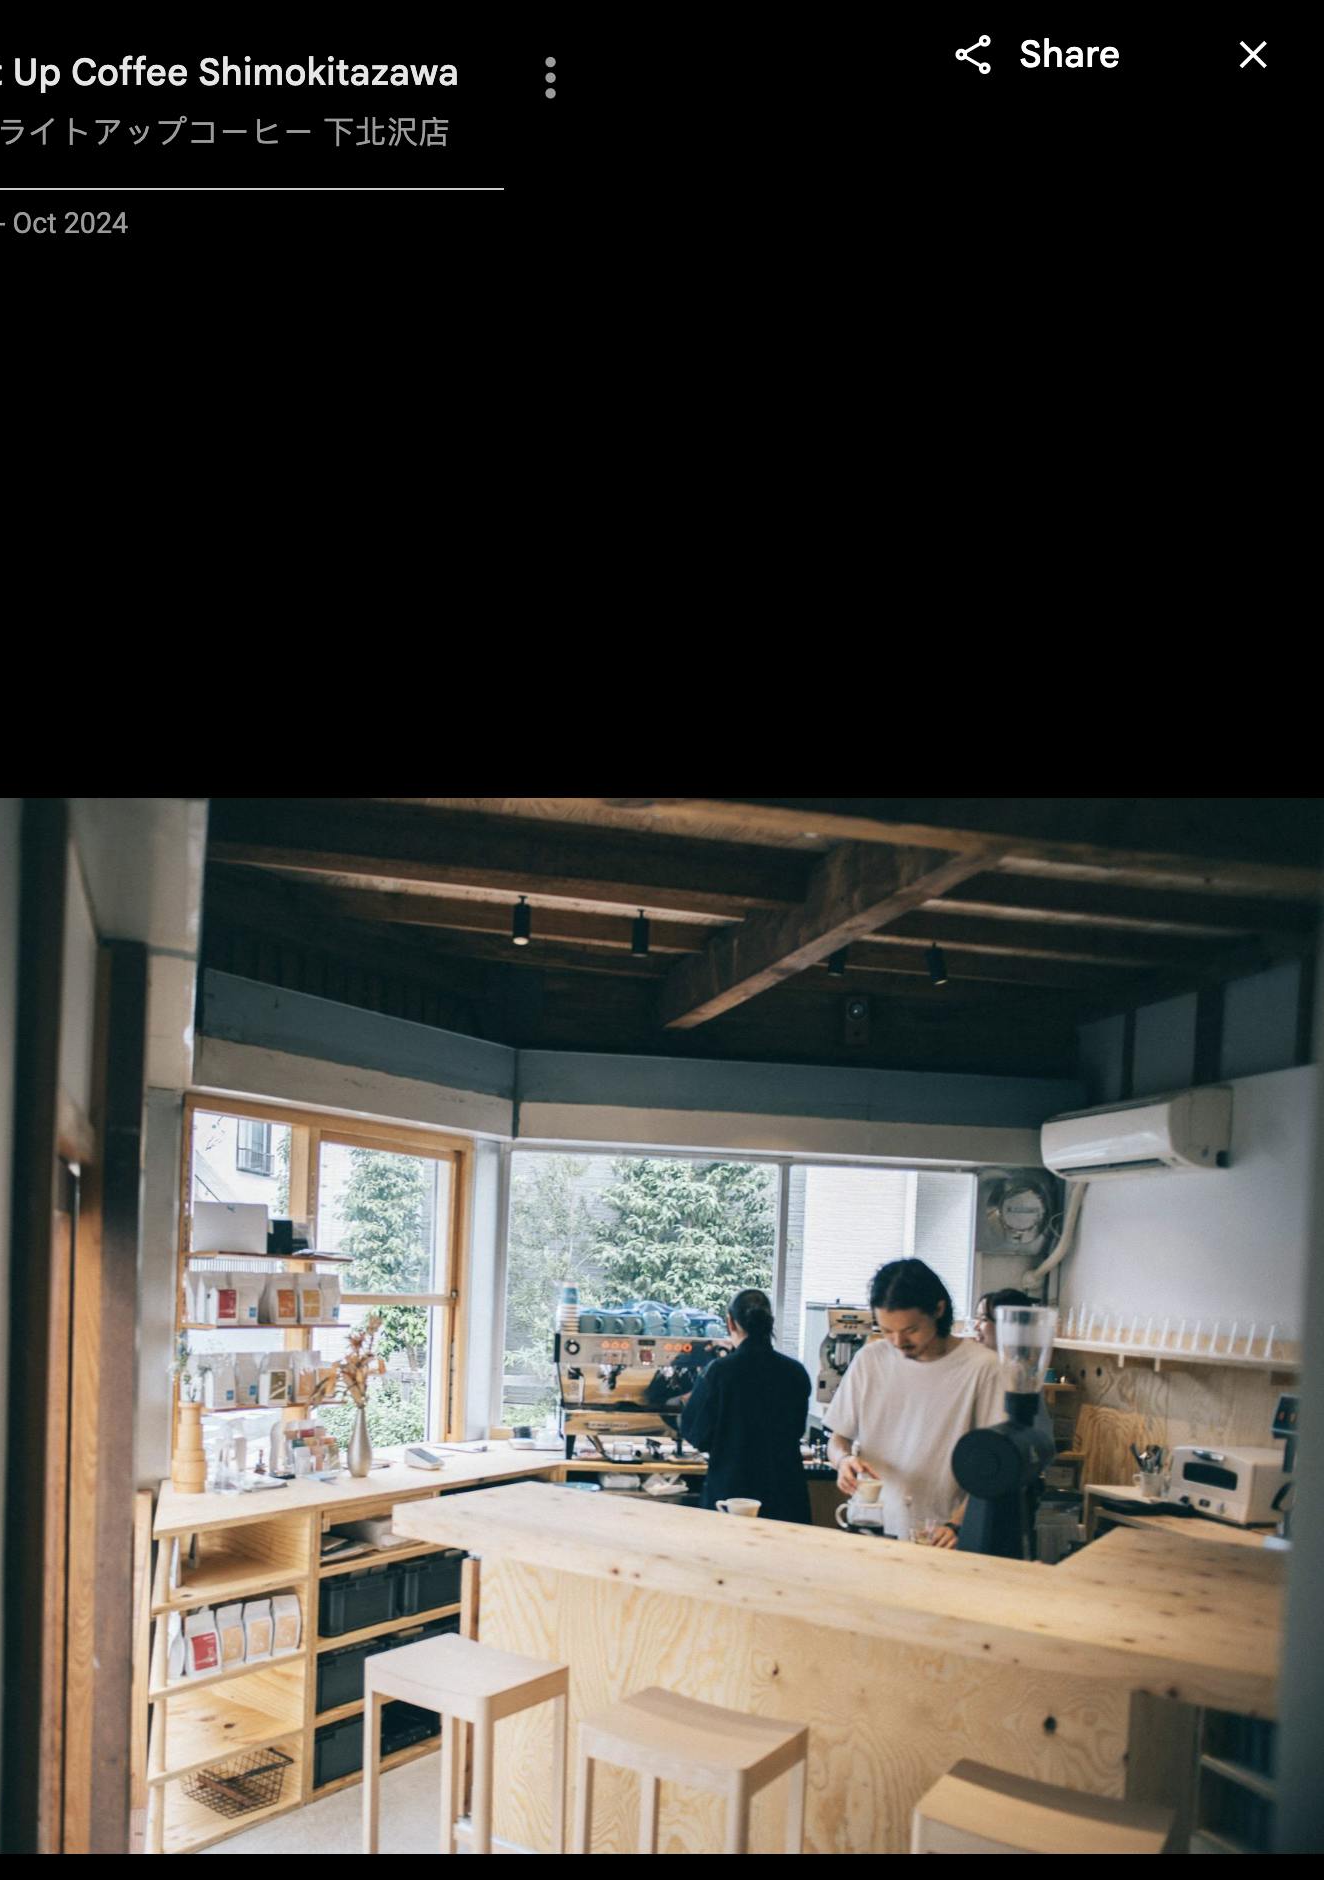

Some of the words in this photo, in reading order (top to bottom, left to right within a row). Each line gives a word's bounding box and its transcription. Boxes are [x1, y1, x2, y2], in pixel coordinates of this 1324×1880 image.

[1019, 37, 1120, 69] Share
[14, 57, 61, 94] Up
[71, 54, 188, 87] Coffee
[198, 55, 458, 87] Shimokitazawa
[0, 116, 312, 146] ライトアップコーヒー
[323, 115, 449, 147] 下北沢店
[13, 211, 57, 234] Oct
[64, 211, 129, 234] 2024
